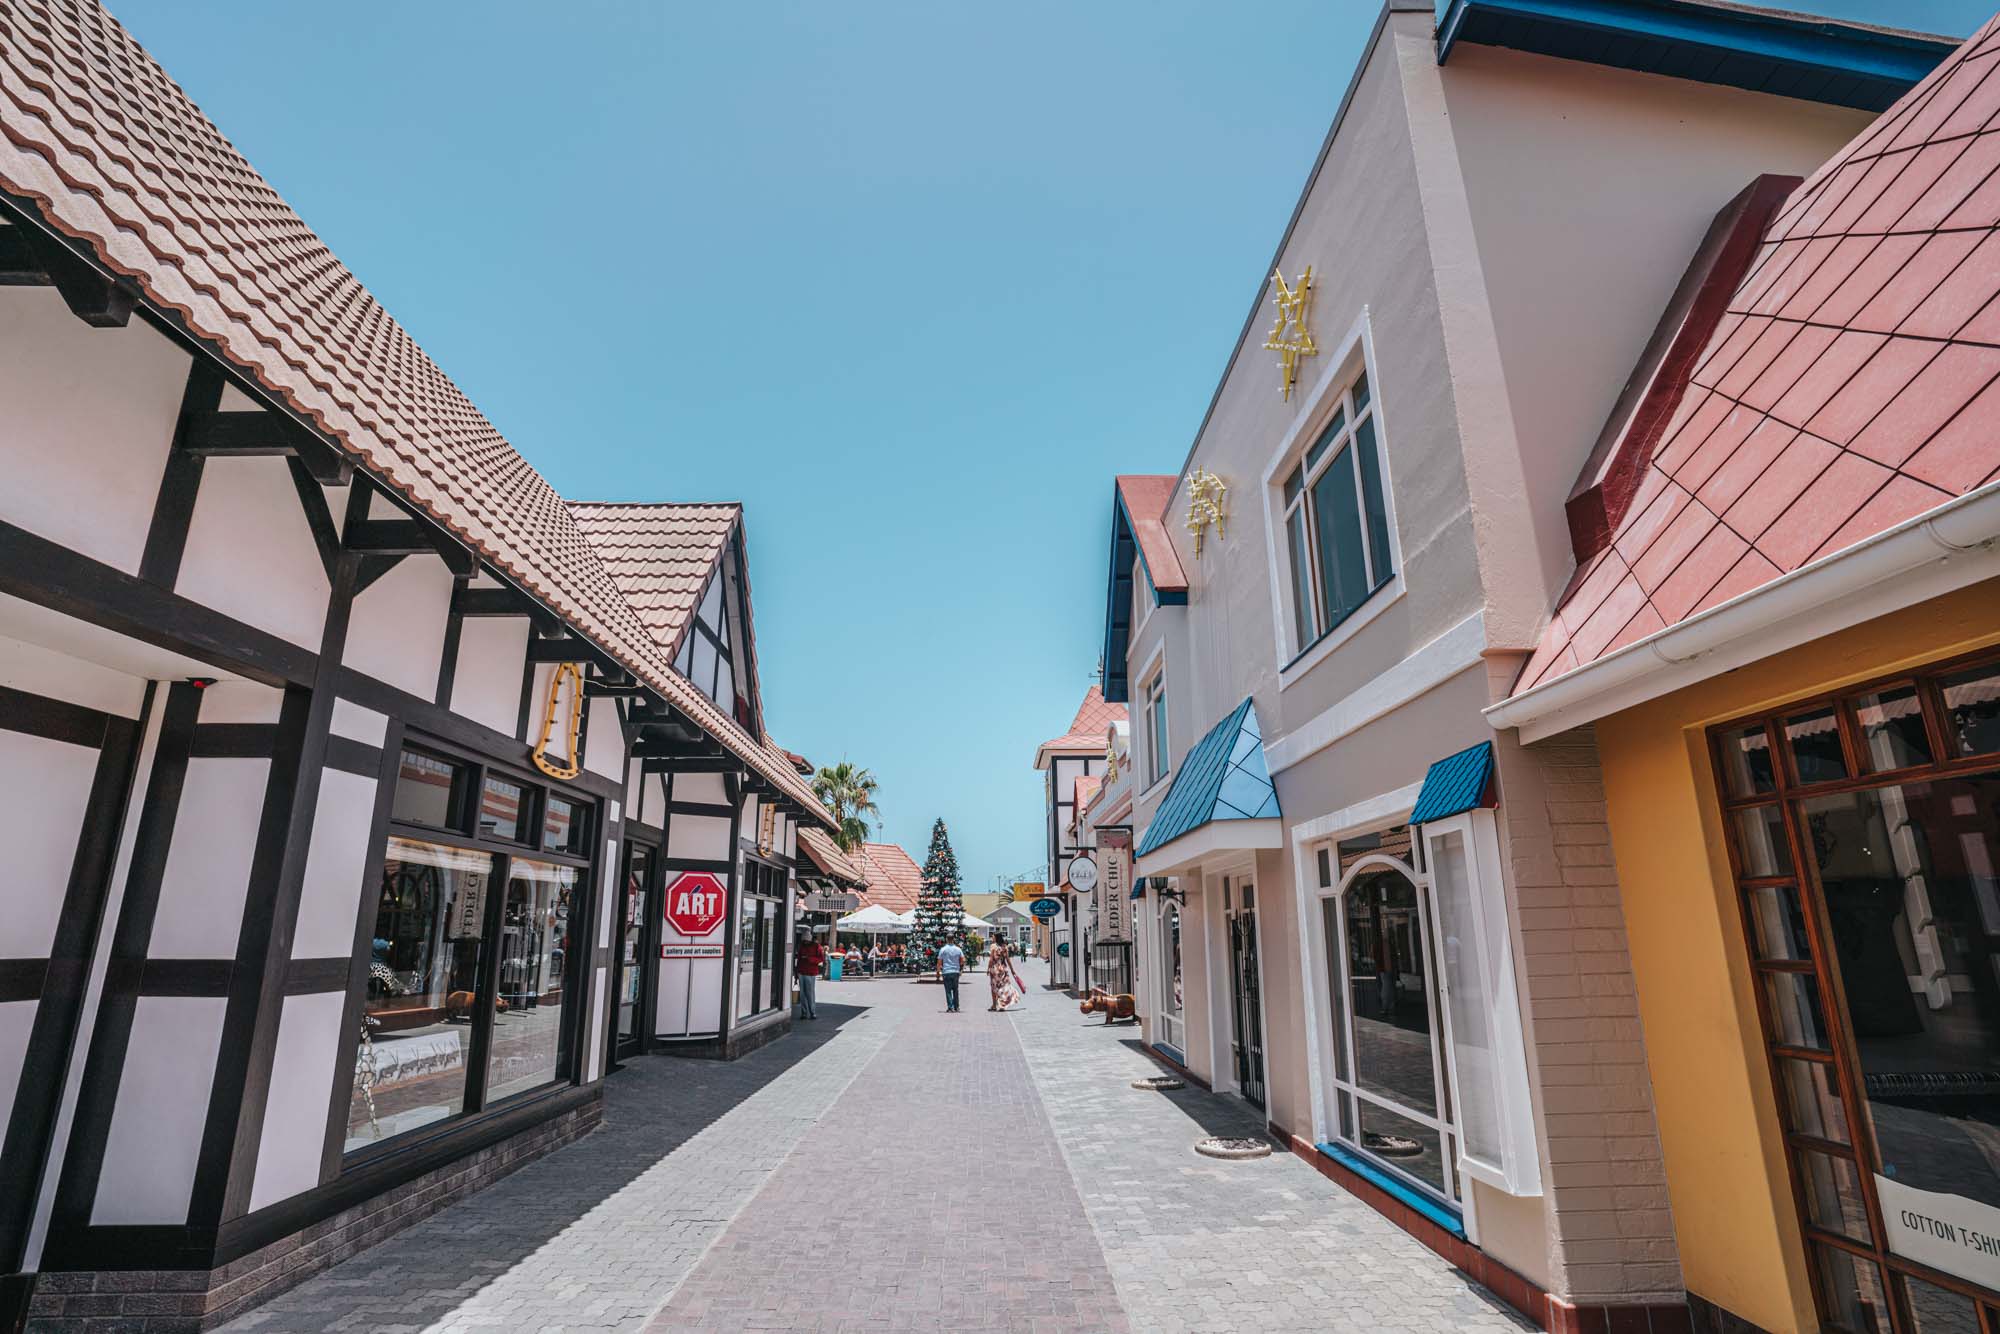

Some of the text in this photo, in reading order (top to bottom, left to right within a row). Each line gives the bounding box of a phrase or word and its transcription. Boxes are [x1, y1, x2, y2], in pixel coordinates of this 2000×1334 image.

[676, 892, 718, 915] ART
[1108, 855, 1120, 938] LEDER CHIC
[1901, 1210, 1956, 1243] COTTON
